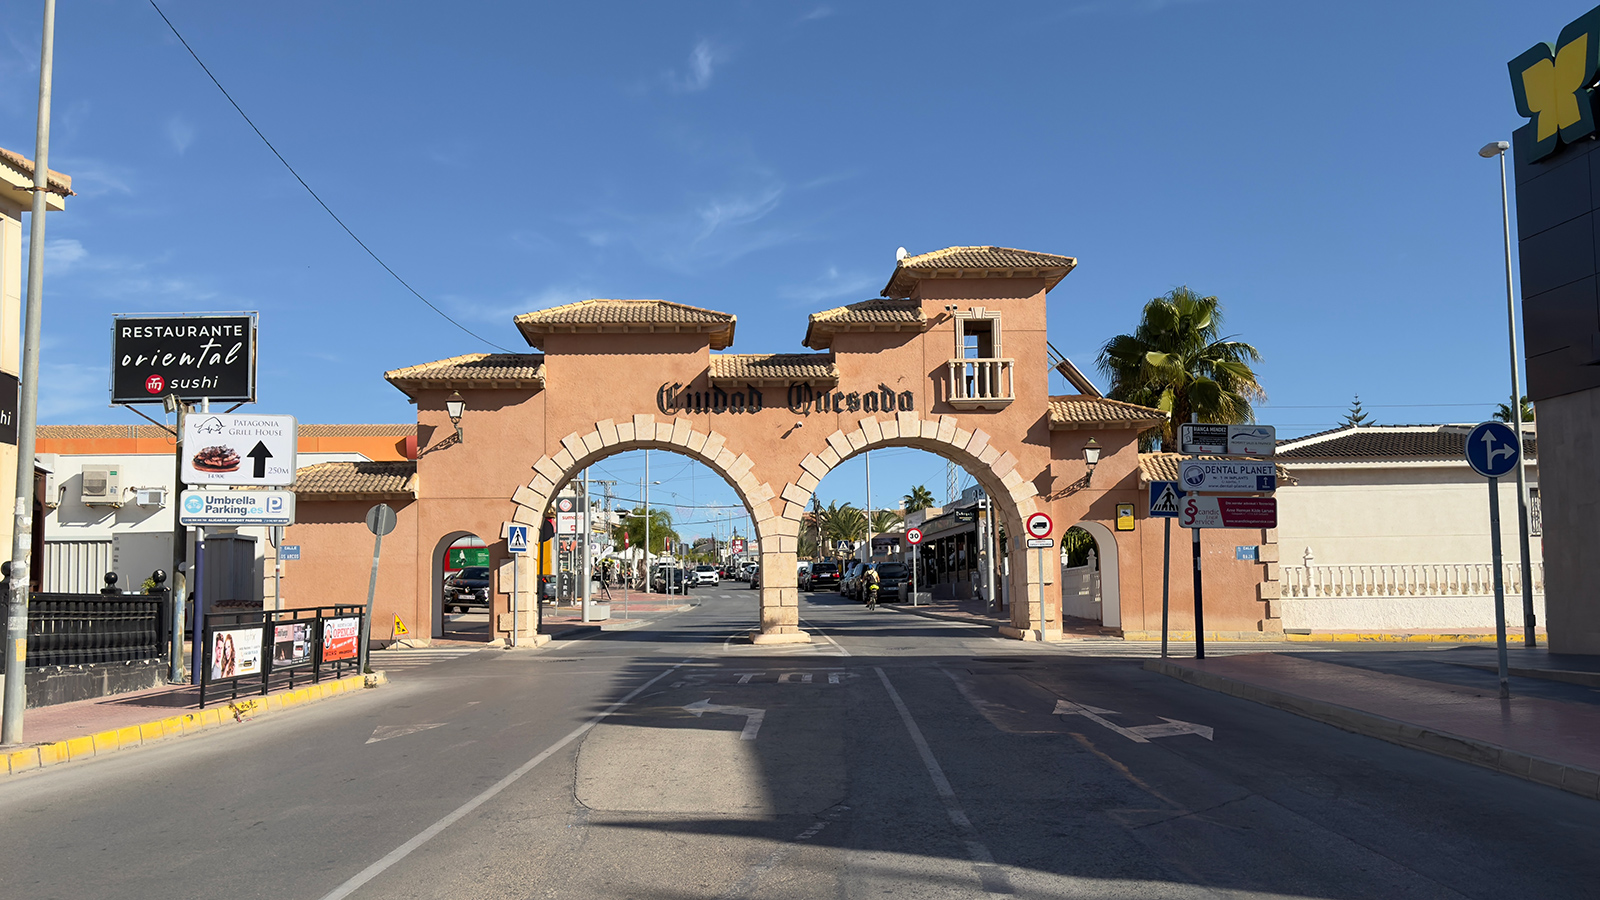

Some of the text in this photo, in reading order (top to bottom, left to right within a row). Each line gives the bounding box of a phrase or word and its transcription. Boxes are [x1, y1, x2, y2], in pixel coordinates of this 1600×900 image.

[122, 325, 243, 338] RESTAURANTE
[121, 337, 242, 369] oriental
[170, 375, 219, 389] sushi
[656, 381, 915, 418] Ciudad Quesada
[1205, 465, 1273, 475] DENTAL PLANET
[205, 495, 256, 505] Umbrella
[205, 505, 264, 516] Parking.es
[669, 672, 861, 688] STOP
